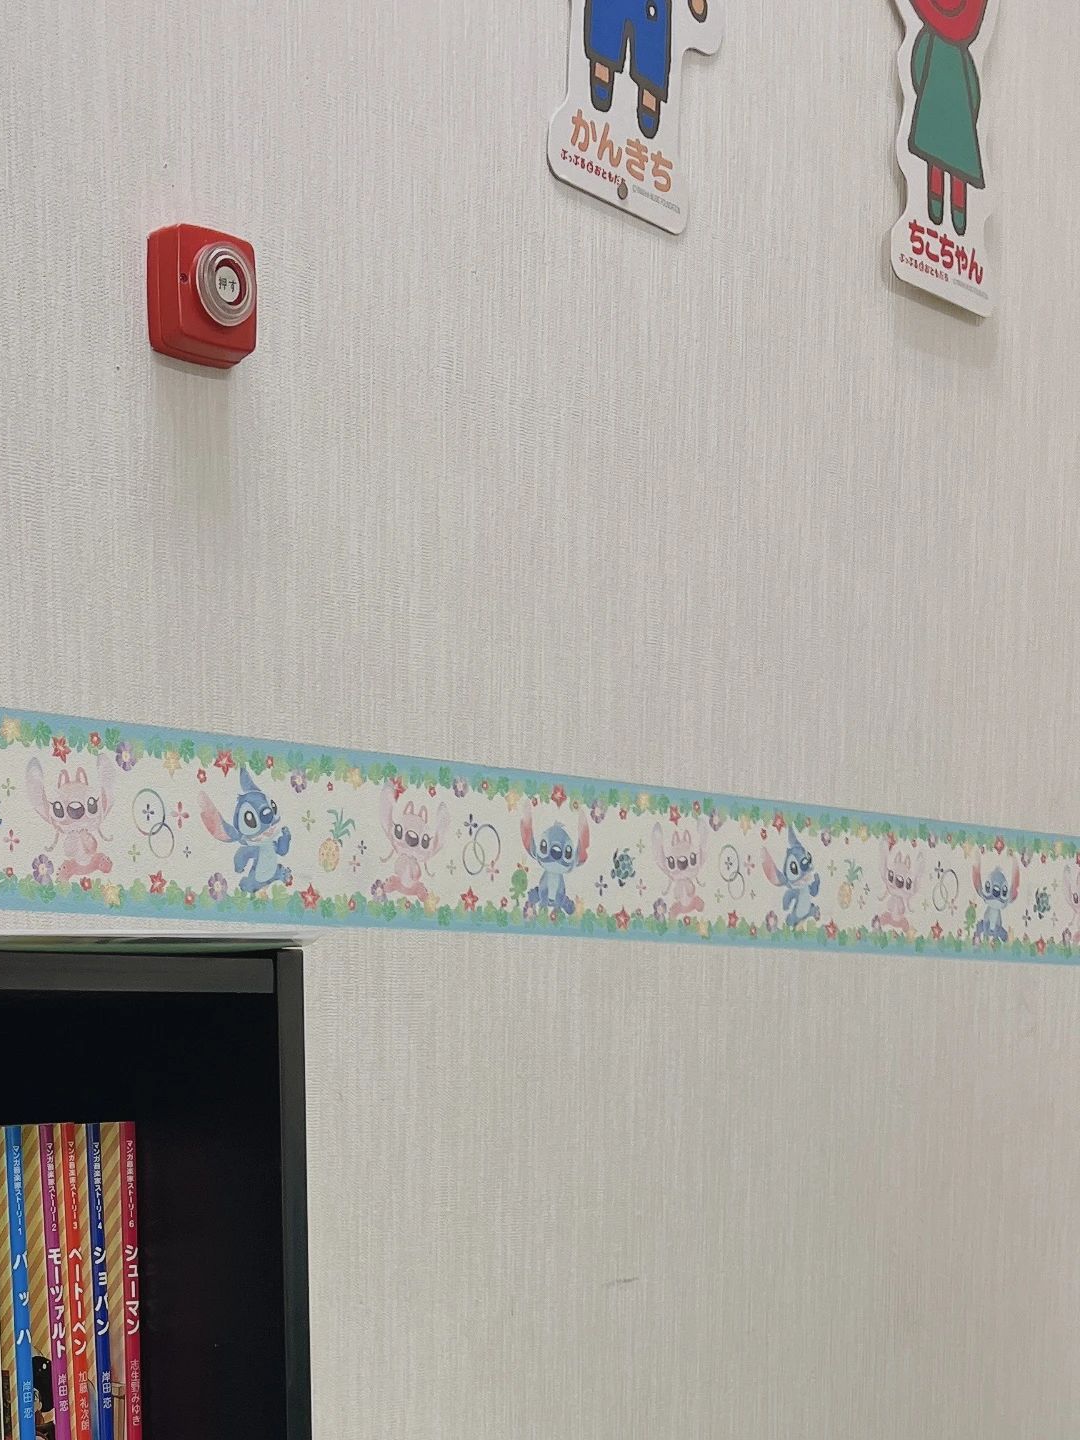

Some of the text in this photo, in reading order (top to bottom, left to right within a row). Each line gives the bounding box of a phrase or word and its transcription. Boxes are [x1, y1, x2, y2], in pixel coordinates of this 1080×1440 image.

[570, 108, 673, 193] かんきち
[908, 219, 984, 285] ちこちゃん
[13, 1250, 32, 1345] バッハ
[48, 1248, 66, 1358] モーツァルト
[68, 1247, 87, 1355] ベートーベン
[93, 1246, 110, 1336] ショパン
[124, 1244, 140, 1335] シューマン
[22, 1380, 33, 1403] 岸田
[57, 1373, 68, 1396] 岸田
[101, 1371, 112, 1394] 岸田
